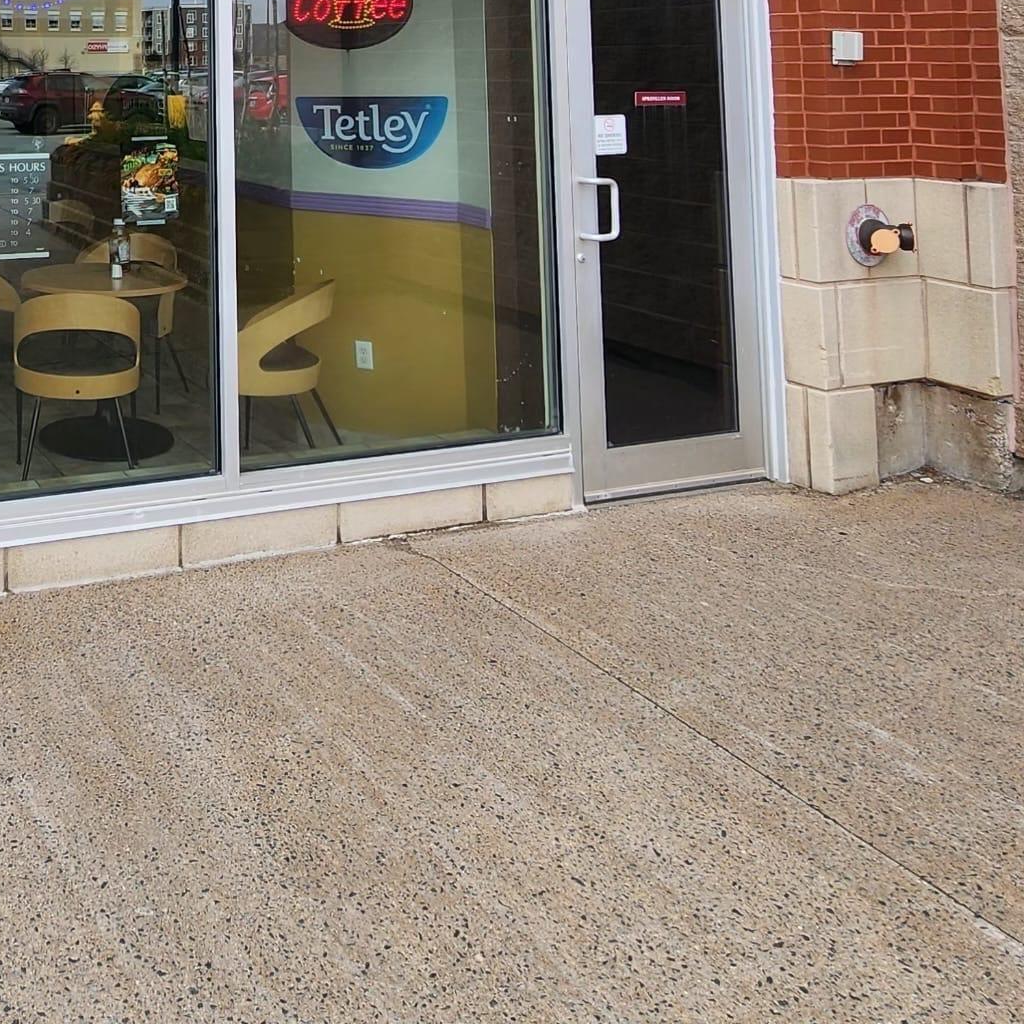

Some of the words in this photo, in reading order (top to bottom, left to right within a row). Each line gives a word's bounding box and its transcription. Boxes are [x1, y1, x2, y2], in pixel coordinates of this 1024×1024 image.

[313, 104, 429, 154] Tetley
[9, 162, 46, 172] HOURS
[27, 207, 33, 215] 7
[26, 218, 32, 226] 7
